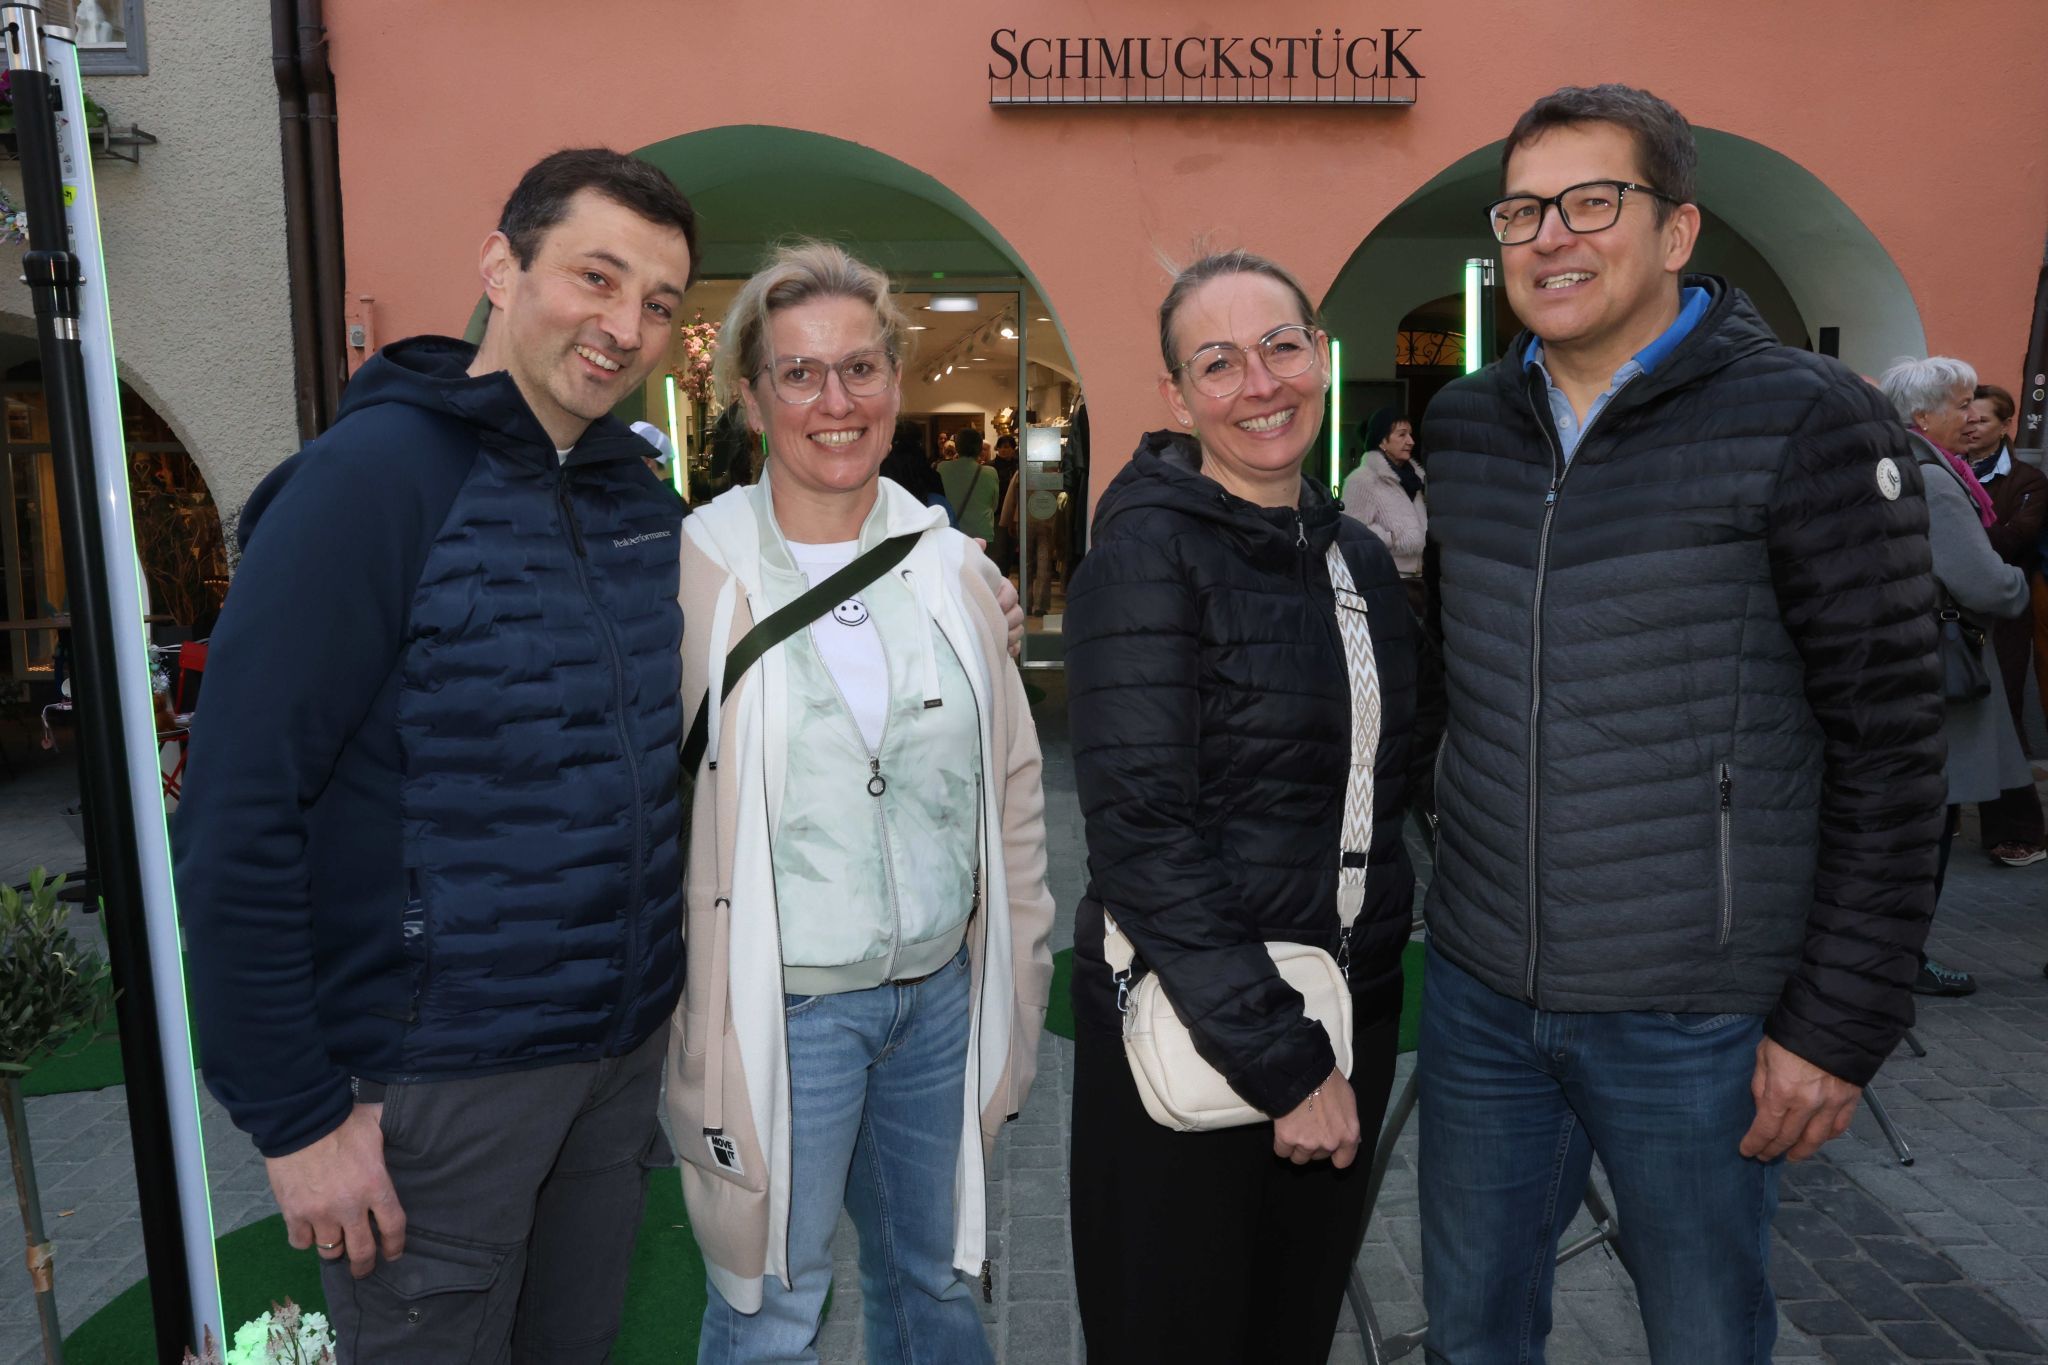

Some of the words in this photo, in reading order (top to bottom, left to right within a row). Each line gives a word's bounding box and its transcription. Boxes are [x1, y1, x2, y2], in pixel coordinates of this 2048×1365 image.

[989, 28, 1426, 79] SCHMUCKSTÜCK
[711, 1136, 734, 1151] MOVE
[727, 1150, 735, 1160] IT
